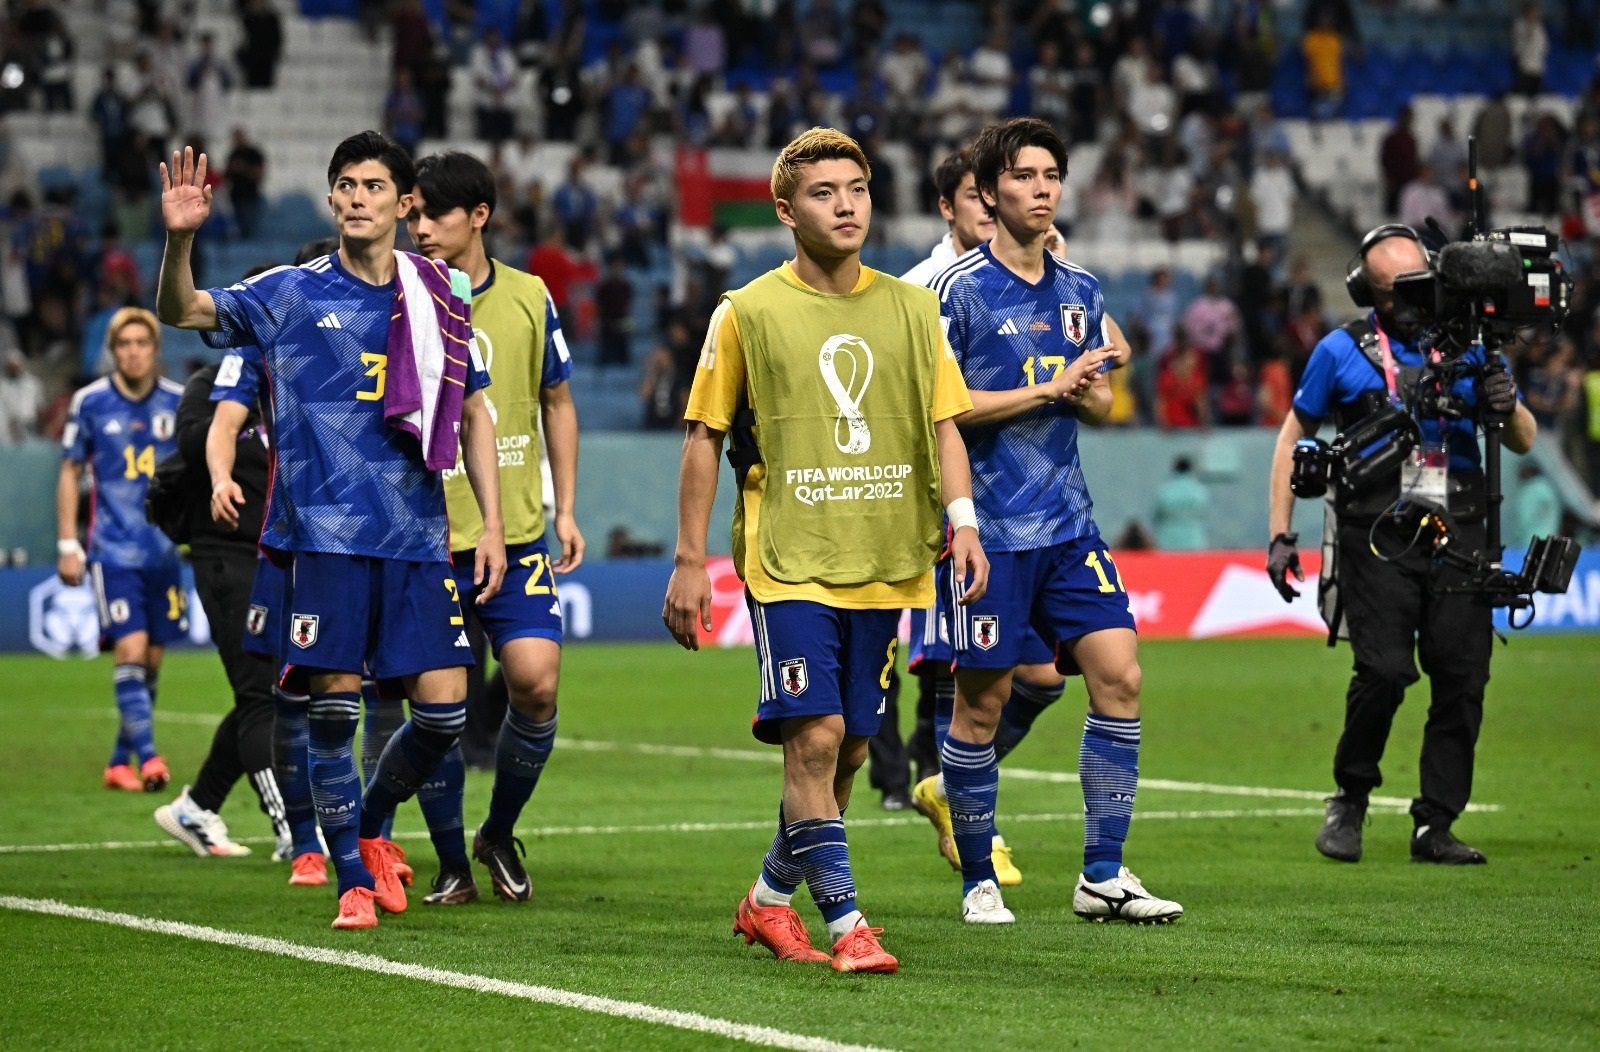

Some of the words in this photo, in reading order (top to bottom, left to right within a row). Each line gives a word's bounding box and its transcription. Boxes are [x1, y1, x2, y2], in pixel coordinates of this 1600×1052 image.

[356, 352, 388, 401] 3
[123, 444, 156, 480] 14
[786, 467, 826, 484] FIFA
[827, 465, 883, 481] WORLD
[883, 464, 913, 478] CUP
